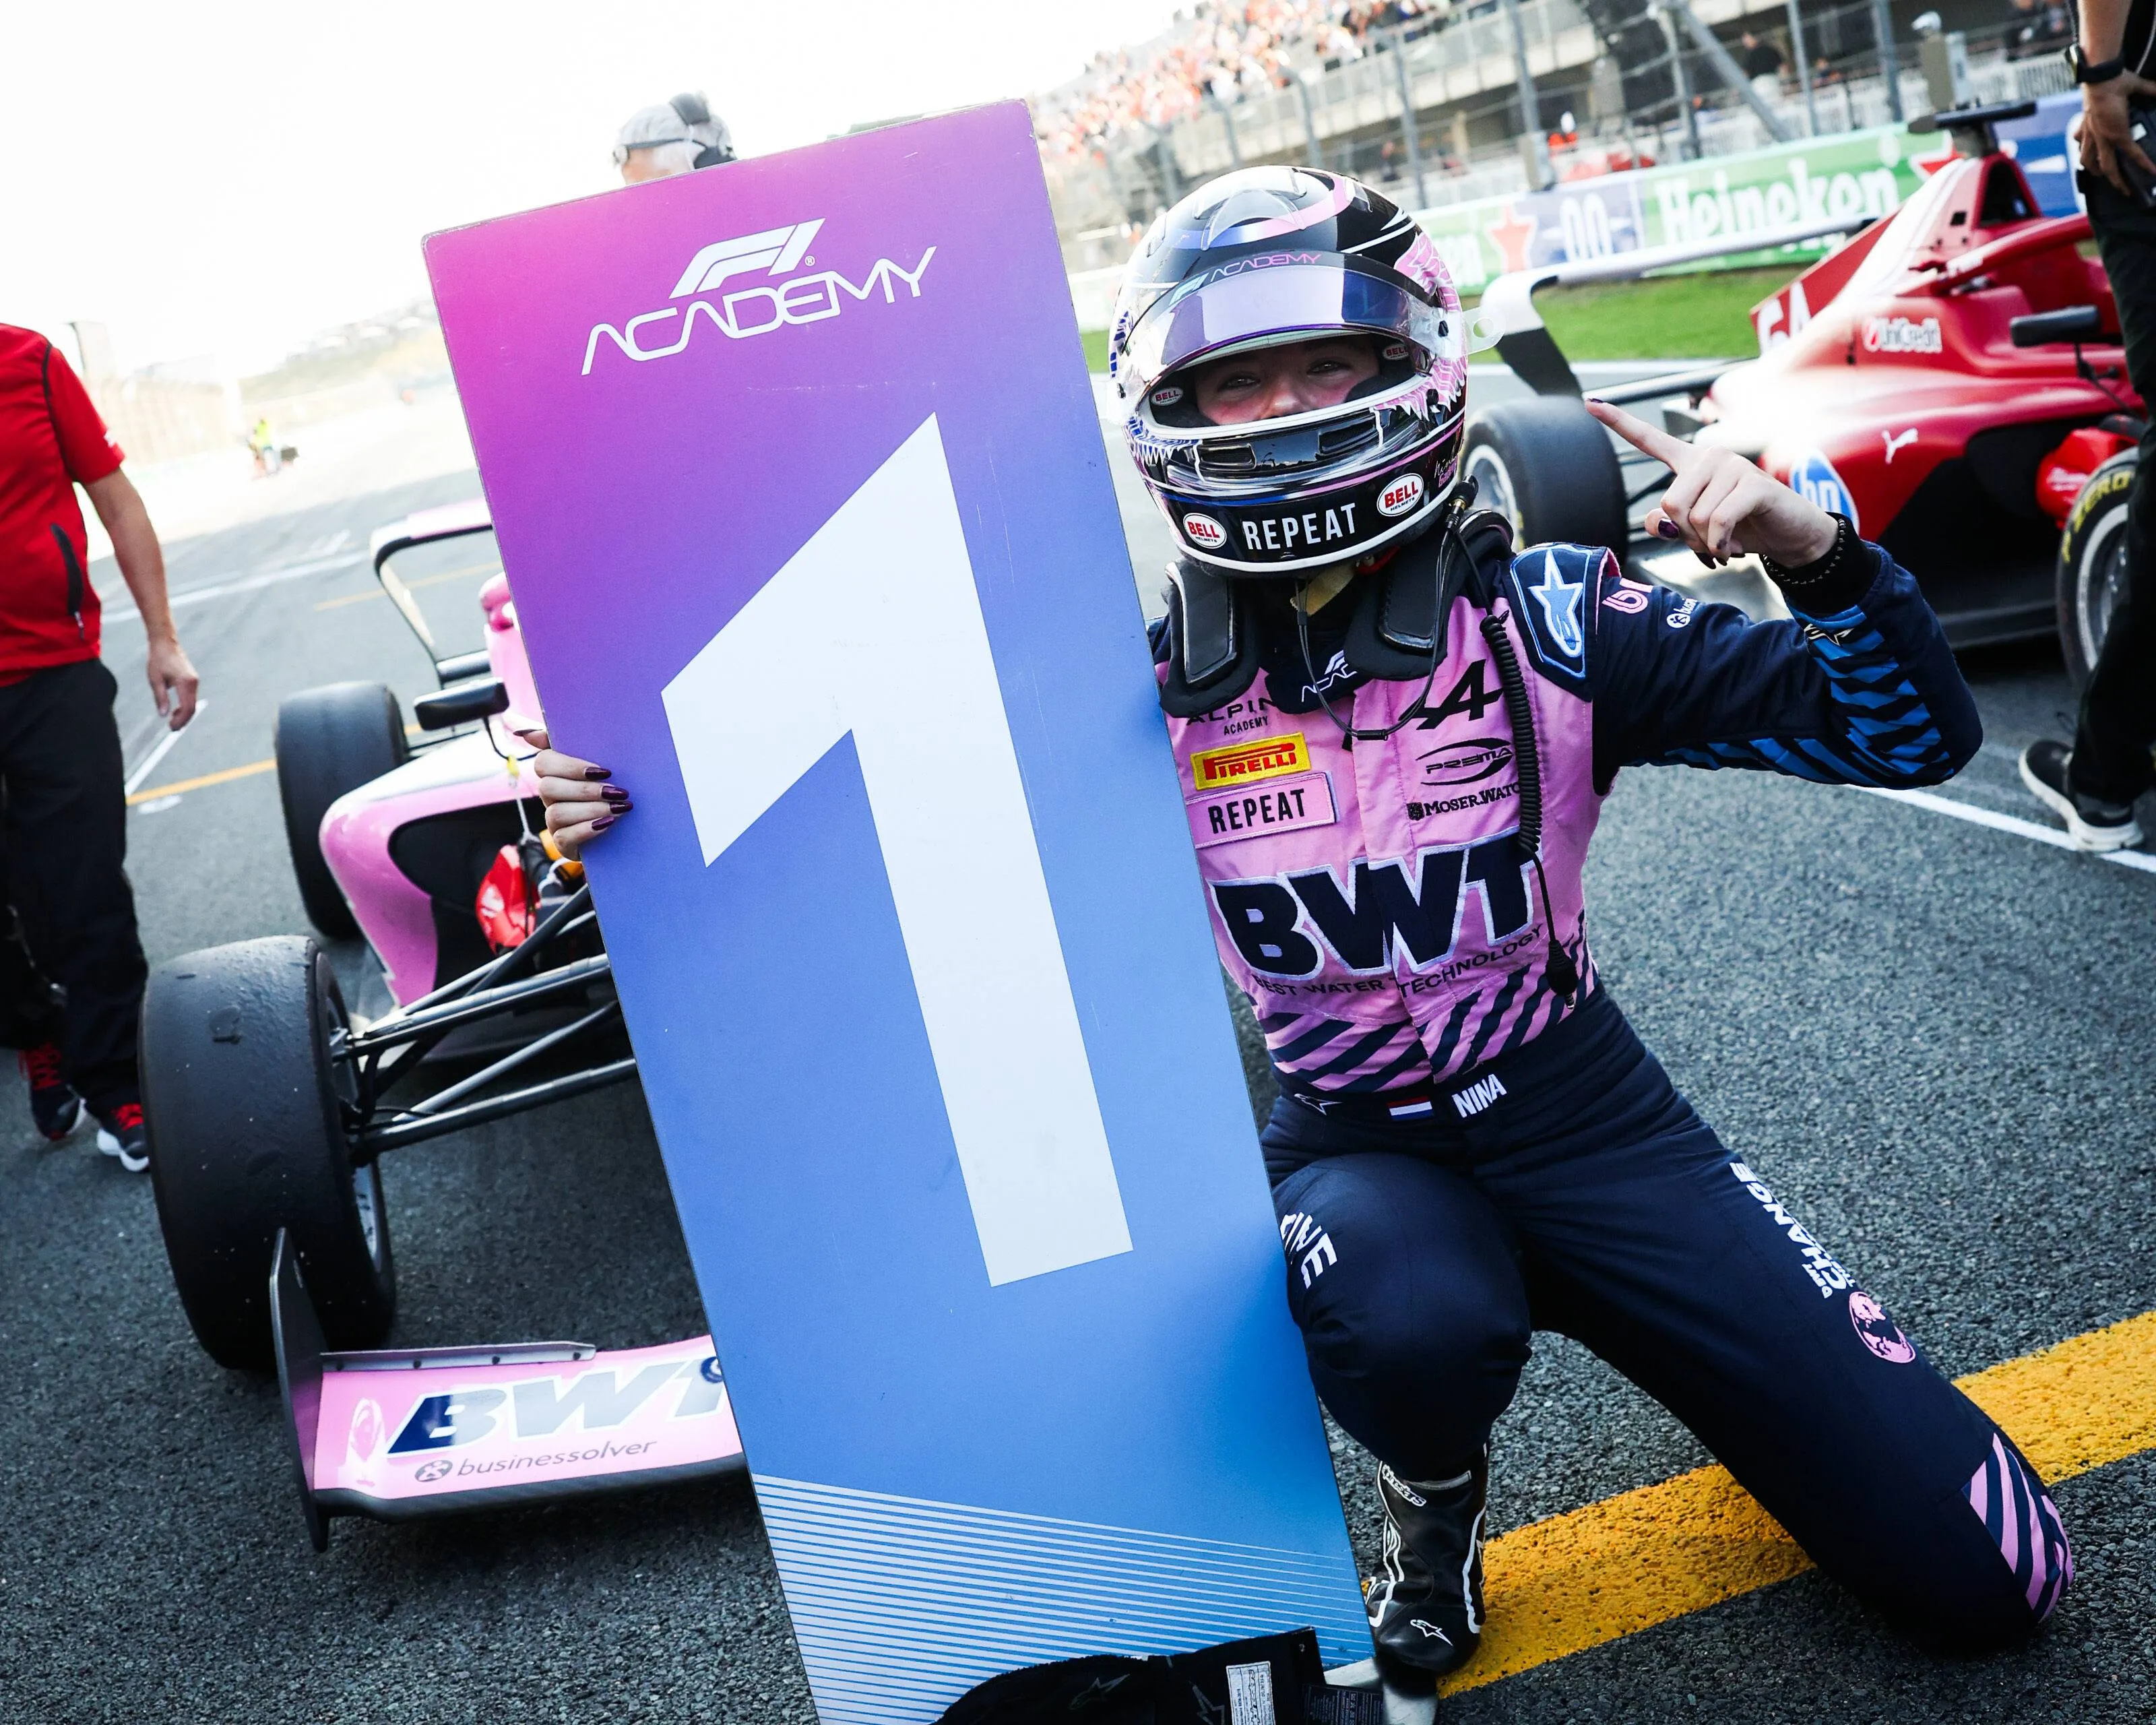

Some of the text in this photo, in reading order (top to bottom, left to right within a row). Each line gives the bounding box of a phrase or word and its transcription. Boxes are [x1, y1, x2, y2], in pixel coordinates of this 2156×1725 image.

[1655, 157, 1899, 243] Heineken
[1211, 253, 1321, 282] ACADEMY
[581, 246, 937, 375] ACADEMY
[1155, 390, 1179, 402] BELL
[1385, 480, 1419, 509] BELL
[1390, 497, 1415, 511] HELMETS
[1187, 521, 1220, 538] BELL
[1242, 503, 1356, 551] REPEAT
[1224, 716, 1269, 736] ACADEMY
[1203, 743, 1297, 780] PIRELLI
[1426, 747, 1513, 774] PREMA
[1207, 788, 1304, 834] REPEAT
[661, 412, 1133, 1287] 1
[1207, 826, 1544, 980] BWT
[1253, 923, 1543, 998] BEST WATER TECHNOLOGY
[1451, 1073, 1507, 1118] NINA
[1729, 1162, 1847, 1290] CHANGE
[387, 1357, 724, 1455] BWT
[457, 1441, 658, 1476] businessolver
